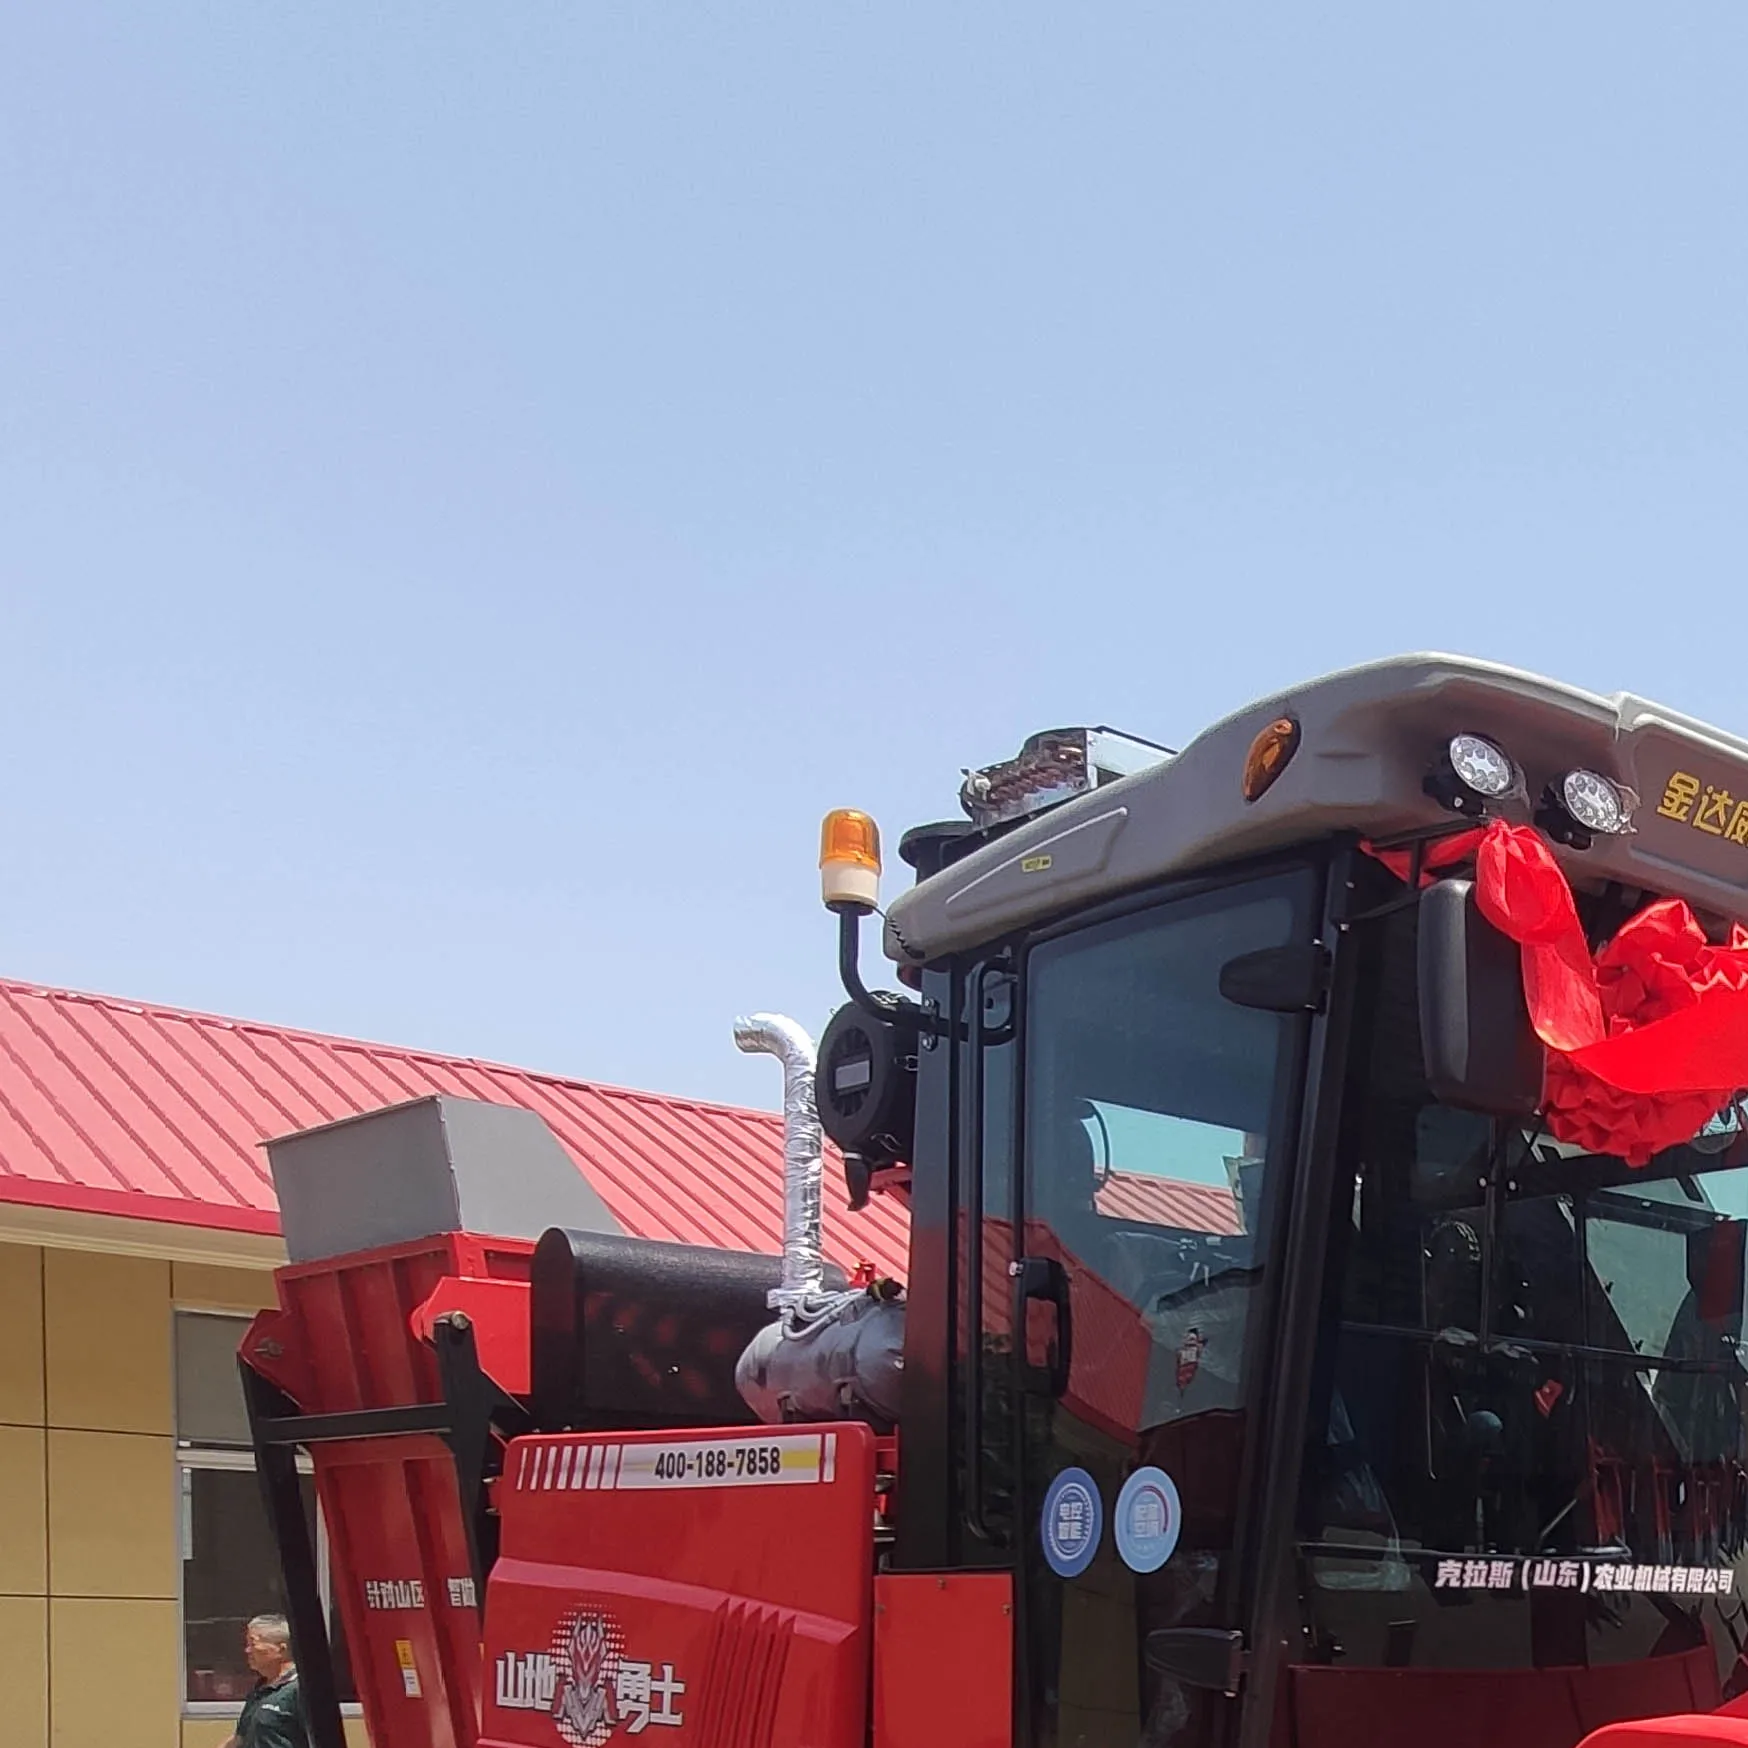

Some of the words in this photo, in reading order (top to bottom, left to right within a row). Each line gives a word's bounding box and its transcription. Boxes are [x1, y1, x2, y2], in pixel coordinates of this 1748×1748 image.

[653, 1446, 781, 1480] 400-188-7858
[495, 1650, 557, 1712] 山地
[616, 1658, 686, 1734] 勇士
